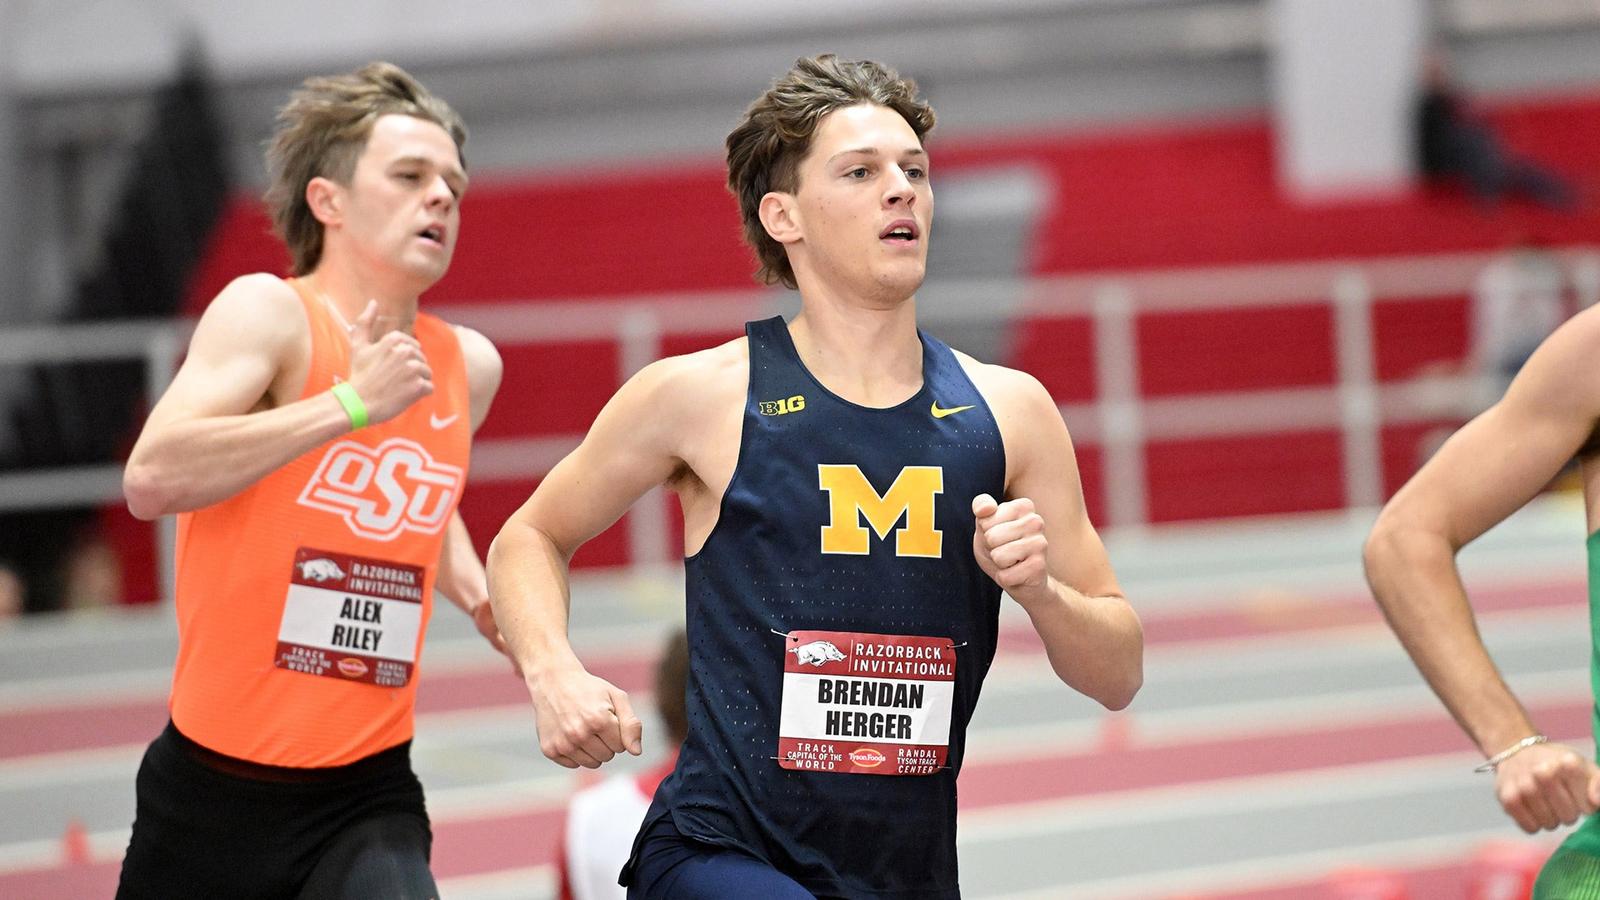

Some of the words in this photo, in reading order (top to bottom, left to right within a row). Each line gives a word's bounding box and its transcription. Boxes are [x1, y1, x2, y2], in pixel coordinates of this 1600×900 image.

[305, 443, 460, 535] OSU
[817, 464, 944, 559] M
[351, 563, 416, 584] RAZORBACK
[349, 578, 421, 599] INVITATIONAL
[340, 597, 383, 624] ALEX
[331, 624, 383, 651] RILEY
[855, 643, 942, 660] RAZORBACK
[853, 660, 953, 676] INVITATIONAL
[818, 679, 924, 709] BRENDAN
[825, 710, 912, 740] HERGER
[787, 751, 817, 760] CAPITAL
[818, 753, 828, 761] OF
[830, 754, 842, 762] THE
[797, 743, 834, 753] TRACK
[898, 748, 937, 758] RANDAL
[795, 760, 834, 770] WORLD
[897, 757, 918, 765] TYSON
[898, 765, 934, 774] CENTER
